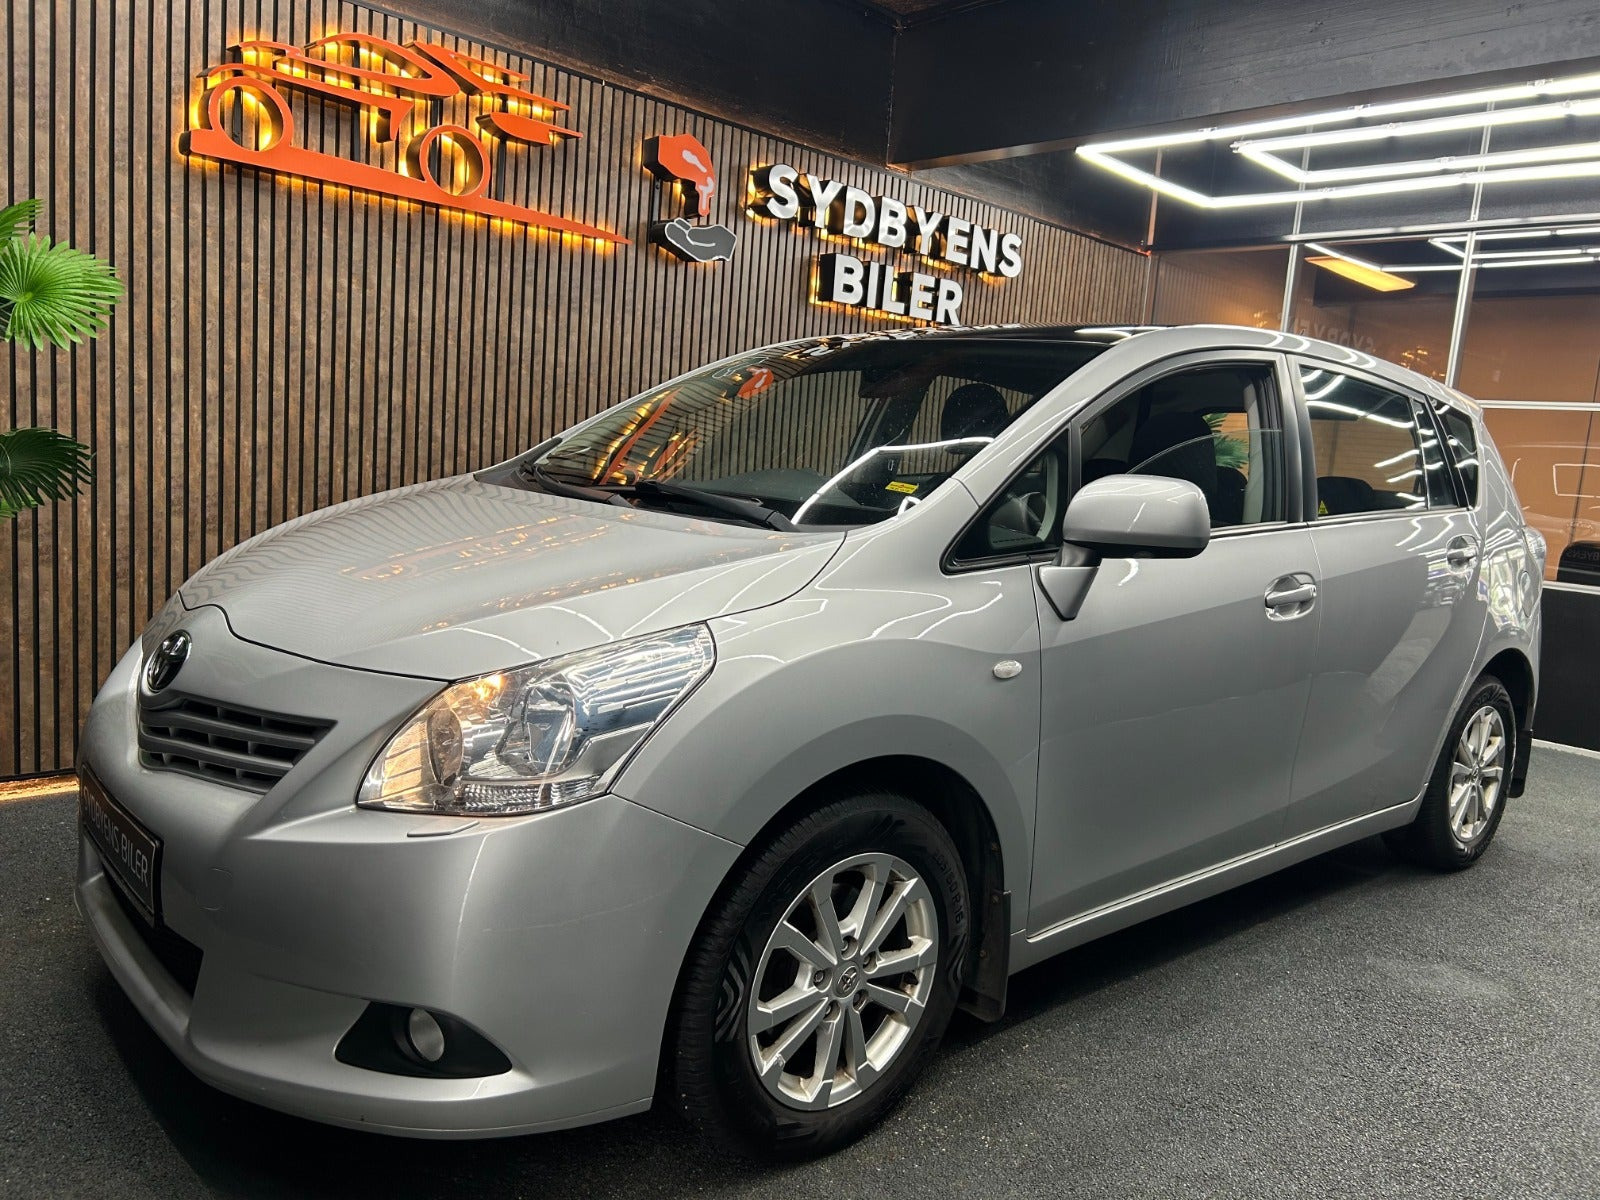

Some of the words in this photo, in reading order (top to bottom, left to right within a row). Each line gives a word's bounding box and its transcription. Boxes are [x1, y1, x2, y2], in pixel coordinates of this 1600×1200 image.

[766, 163, 1023, 279] SYDBYENS
[831, 252, 963, 326] BILER
[121, 832, 149, 888] BILER
